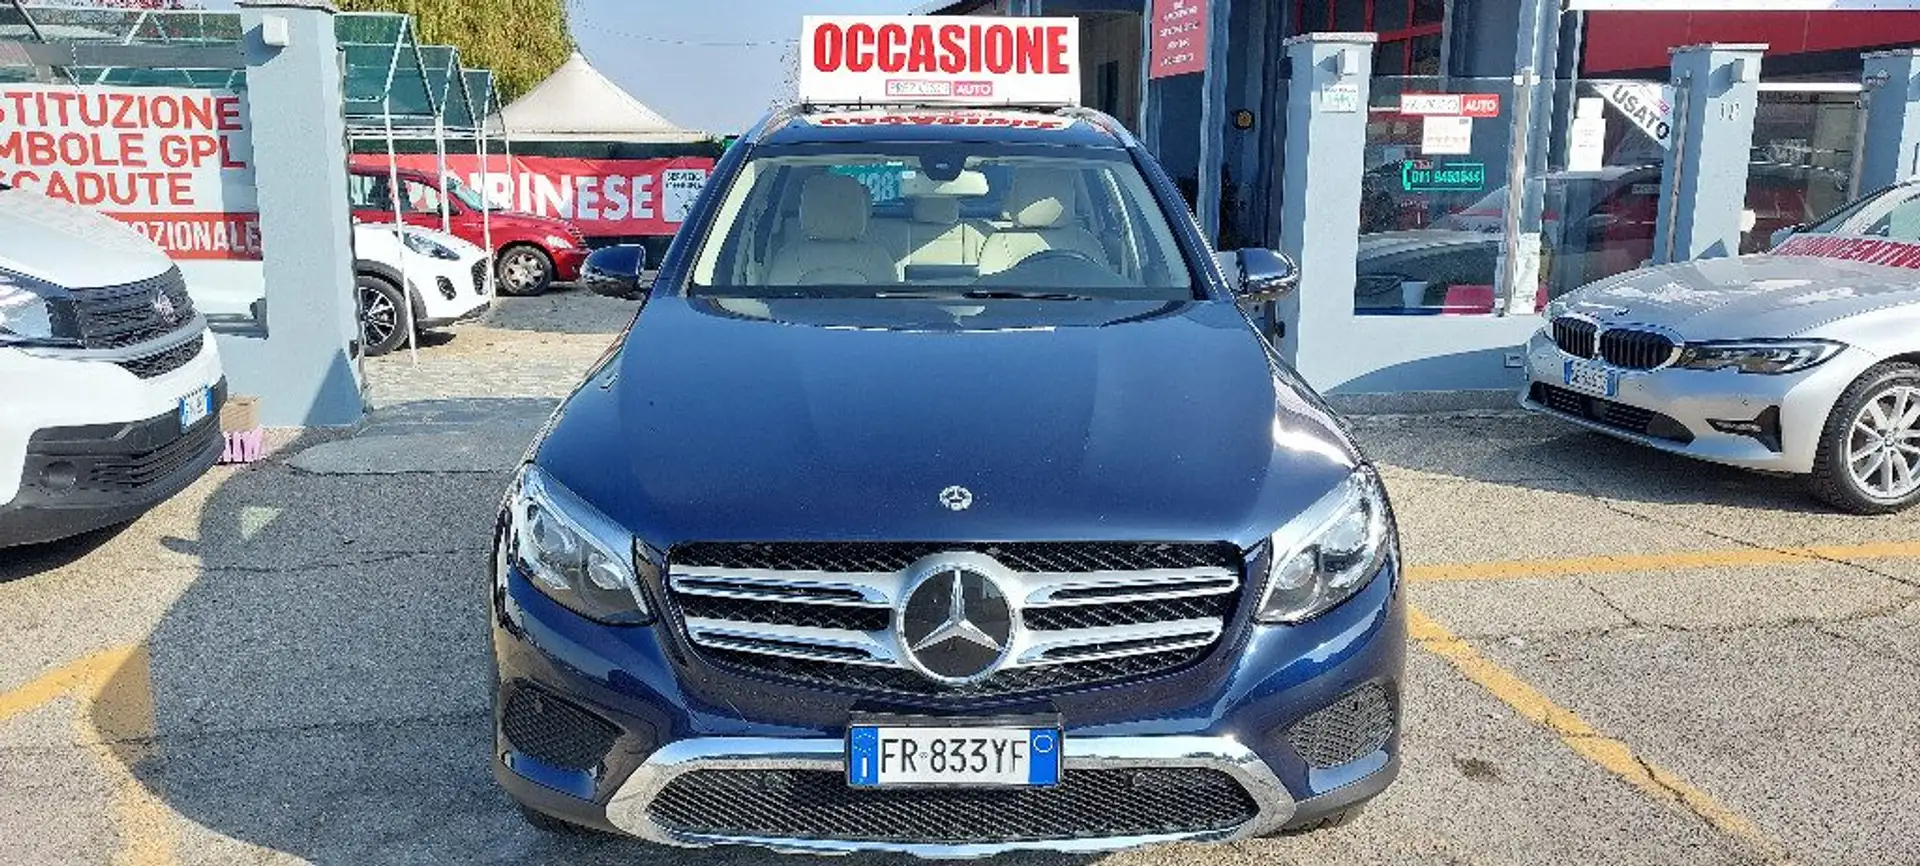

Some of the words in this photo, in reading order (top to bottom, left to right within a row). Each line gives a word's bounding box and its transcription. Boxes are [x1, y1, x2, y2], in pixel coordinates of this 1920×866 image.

[813, 22, 1070, 75] OCCASIONE
[956, 83, 991, 95] AUTO
[1464, 99, 1497, 114] AUTO
[0, 90, 243, 131] TITUZIONE
[1612, 84, 1670, 140] USATO
[160, 134, 247, 169] GPL
[0, 170, 195, 206] CADUTE
[125, 219, 262, 252] OZIONALE
[881, 738, 918, 773] FR
[930, 738, 1028, 773] 833YF
